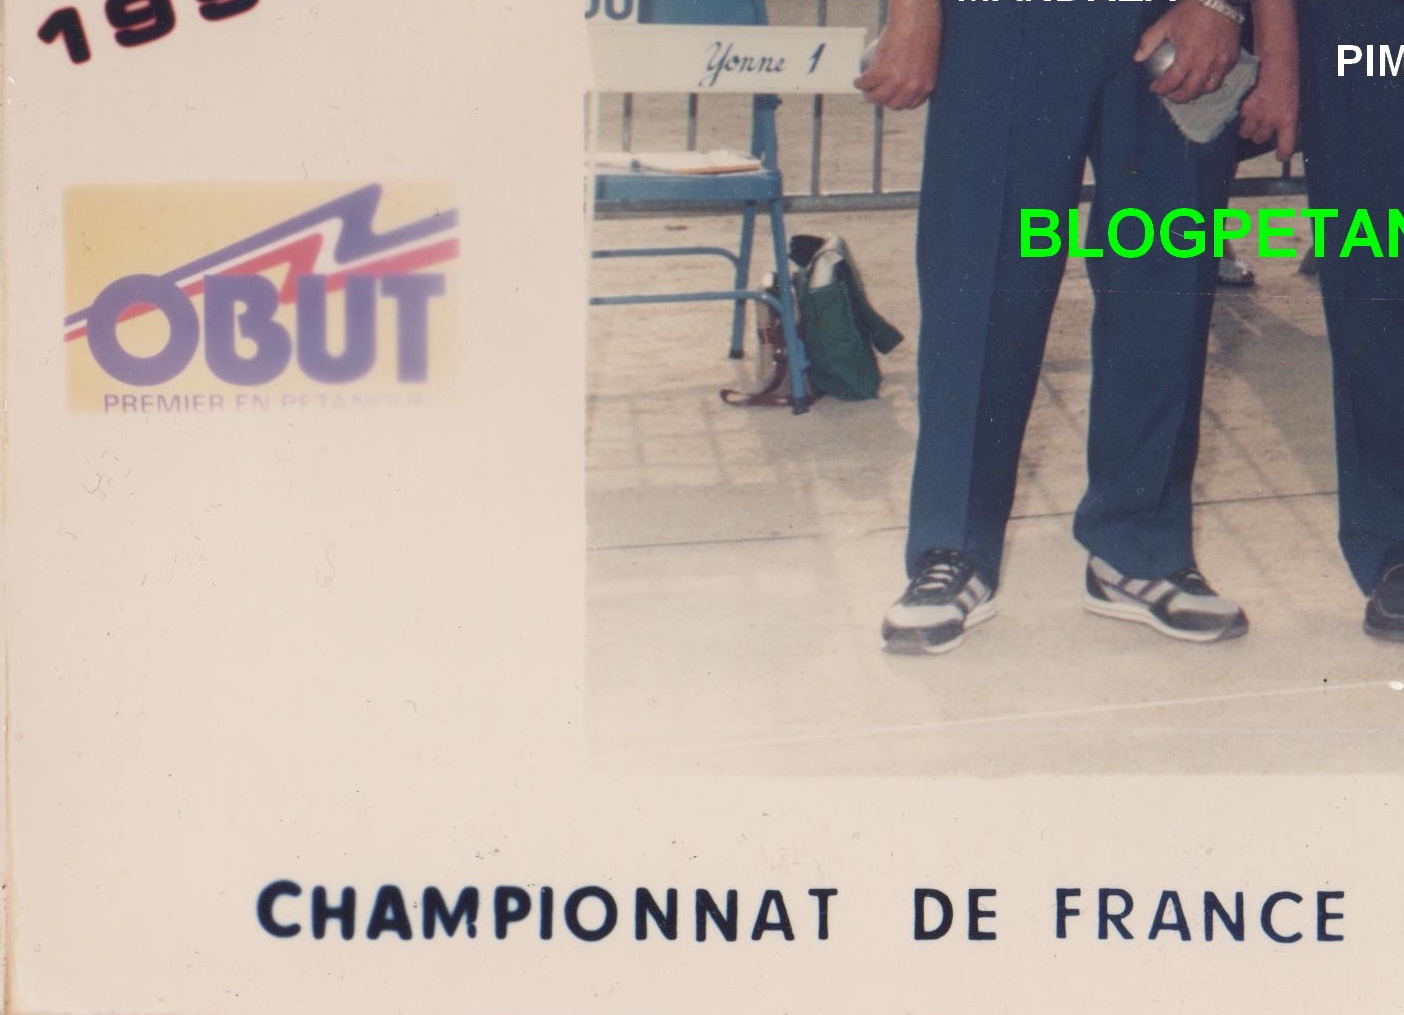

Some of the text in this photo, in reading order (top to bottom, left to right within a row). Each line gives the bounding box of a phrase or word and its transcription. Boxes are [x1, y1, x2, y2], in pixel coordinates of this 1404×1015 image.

[698, 41, 827, 87] Yonne 1
[87, 273, 446, 387] OBUT
[103, 391, 424, 414] PREMIER EN PETAN
[256, 878, 840, 944] CHAMPIONNAT
[914, 887, 998, 942] DE
[1055, 887, 1346, 944] FRANCE
